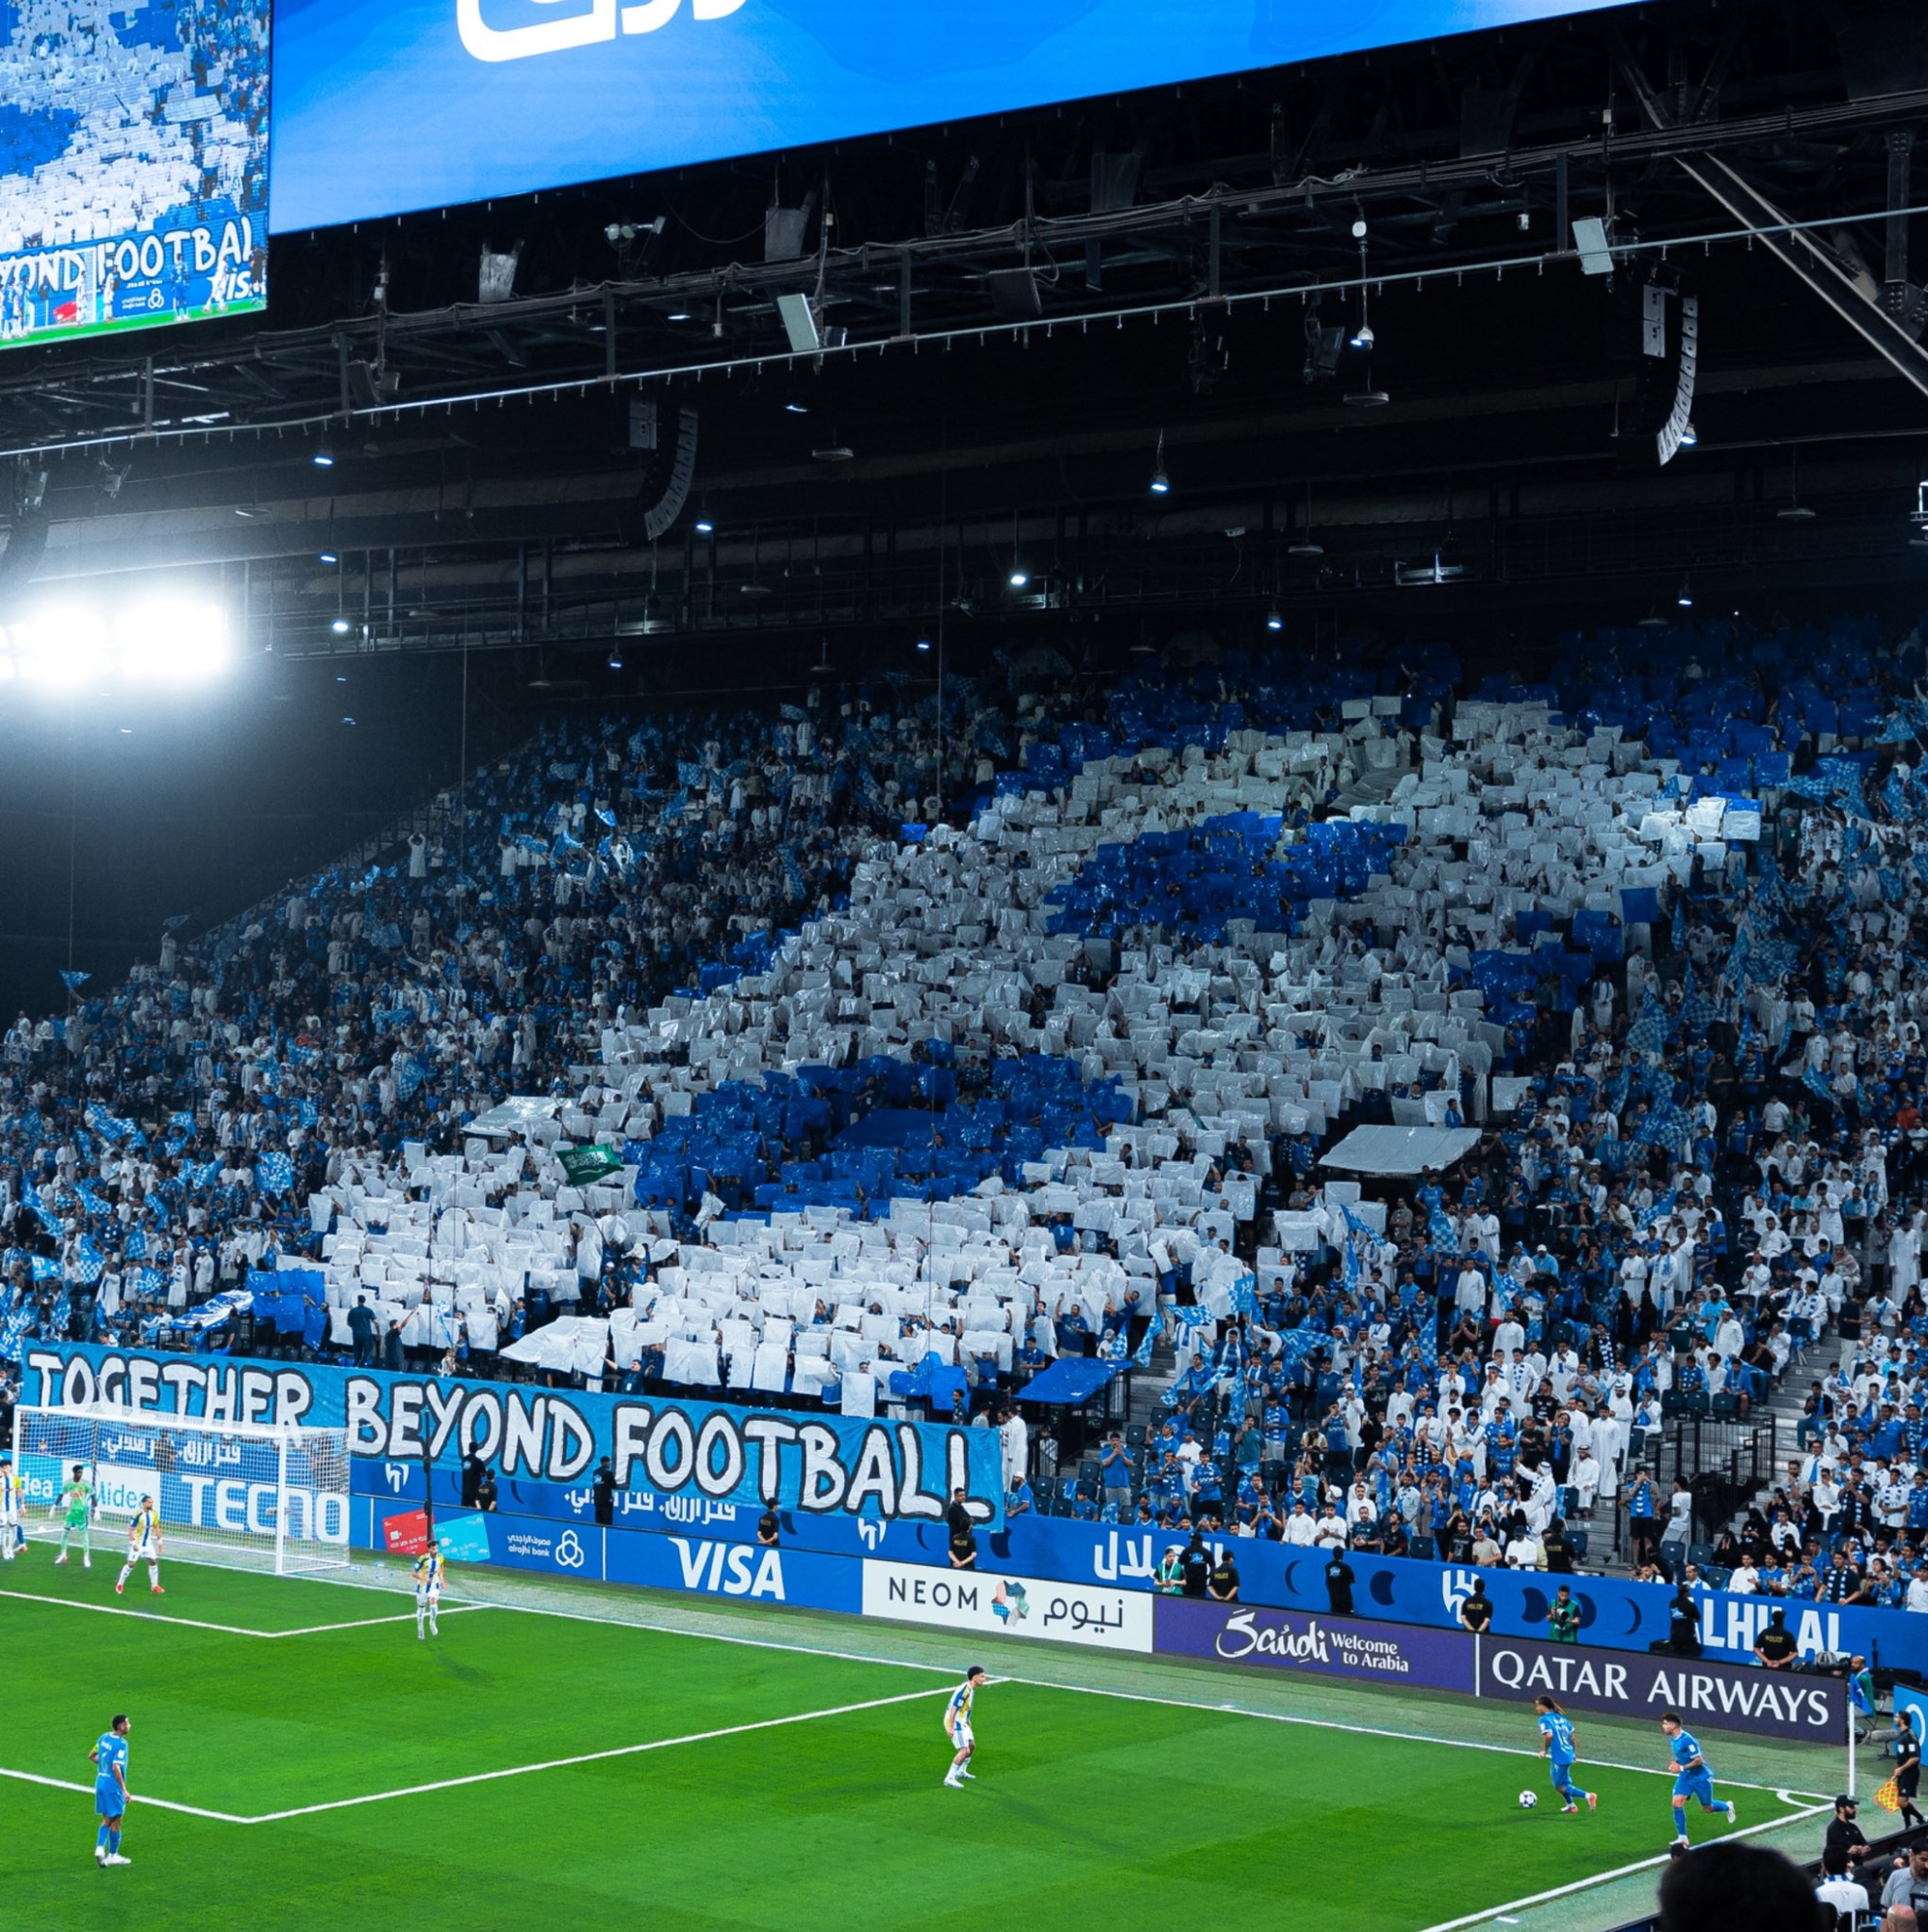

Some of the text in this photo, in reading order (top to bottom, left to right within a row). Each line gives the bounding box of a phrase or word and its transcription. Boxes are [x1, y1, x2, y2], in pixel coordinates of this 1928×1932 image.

[27, 1352, 993, 1520] TOGETHER BEYOND FOOTBALL
[20, 1471, 53, 1499] dea
[532, 1547, 550, 1557] bank
[667, 1537, 785, 1601] VISA
[890, 1577, 978, 1610] NEOM
[1044, 1598, 1123, 1634] نيوم
[1216, 1607, 1330, 1663] Saudi
[1331, 1633, 1398, 1656] Welcome
[1343, 1650, 1409, 1672] to Arabia
[1492, 1651, 1829, 1726] QATAR AIRWAYS
